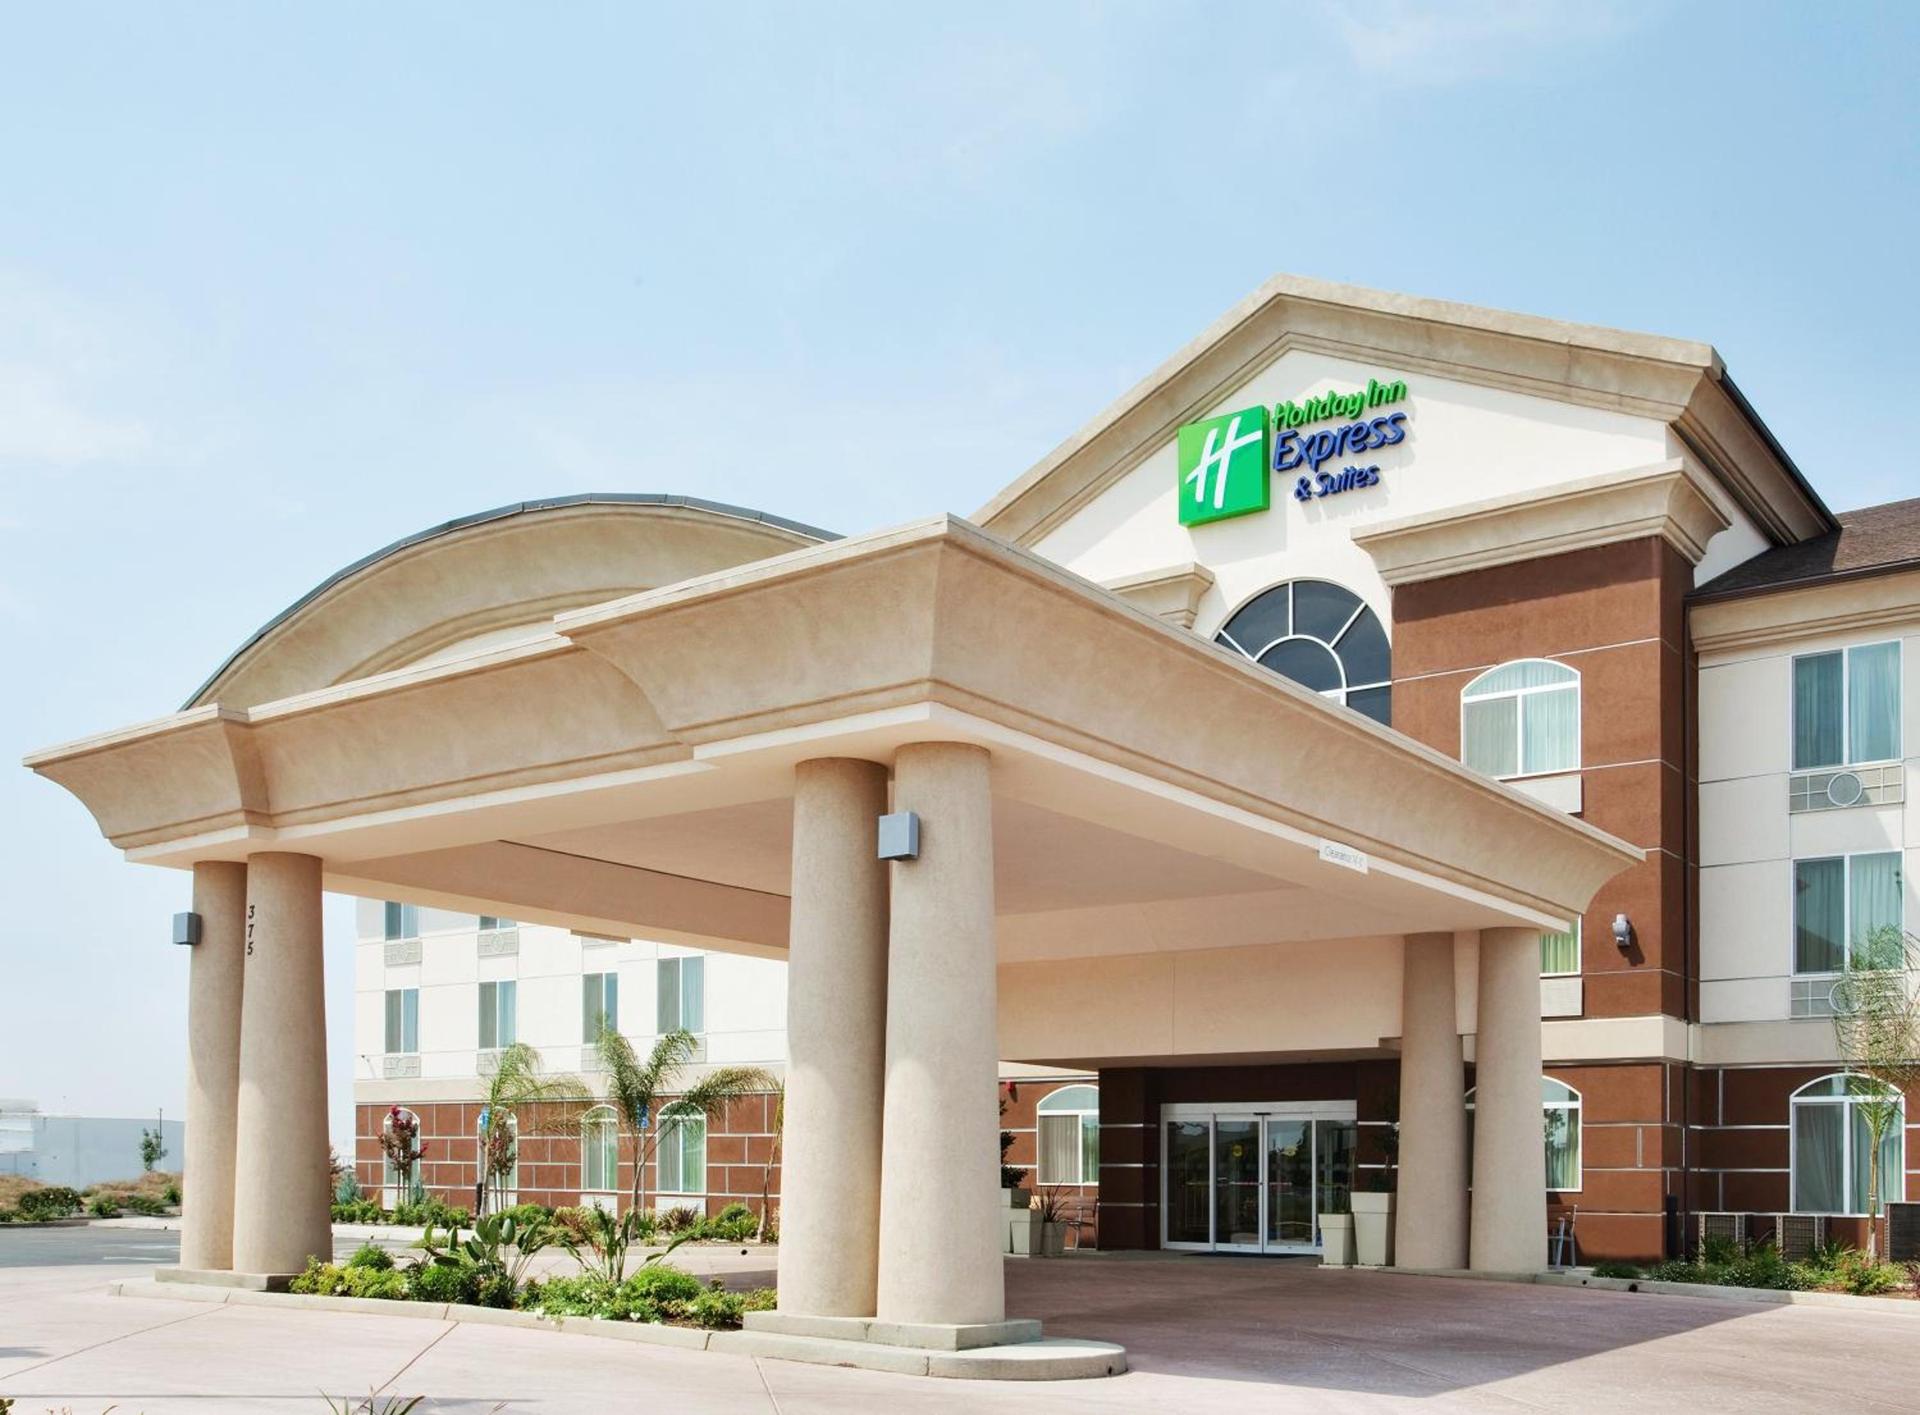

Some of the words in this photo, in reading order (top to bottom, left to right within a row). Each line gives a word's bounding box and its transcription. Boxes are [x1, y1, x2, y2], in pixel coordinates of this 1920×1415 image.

[1272, 390, 1364, 431] Holiday
[1366, 378, 1407, 407] Inn
[1185, 416, 1262, 509] H
[1272, 412, 1407, 472] Express
[1294, 476, 1313, 501] &
[1315, 465, 1380, 497] Suites
[247, 904, 255, 956] 375
